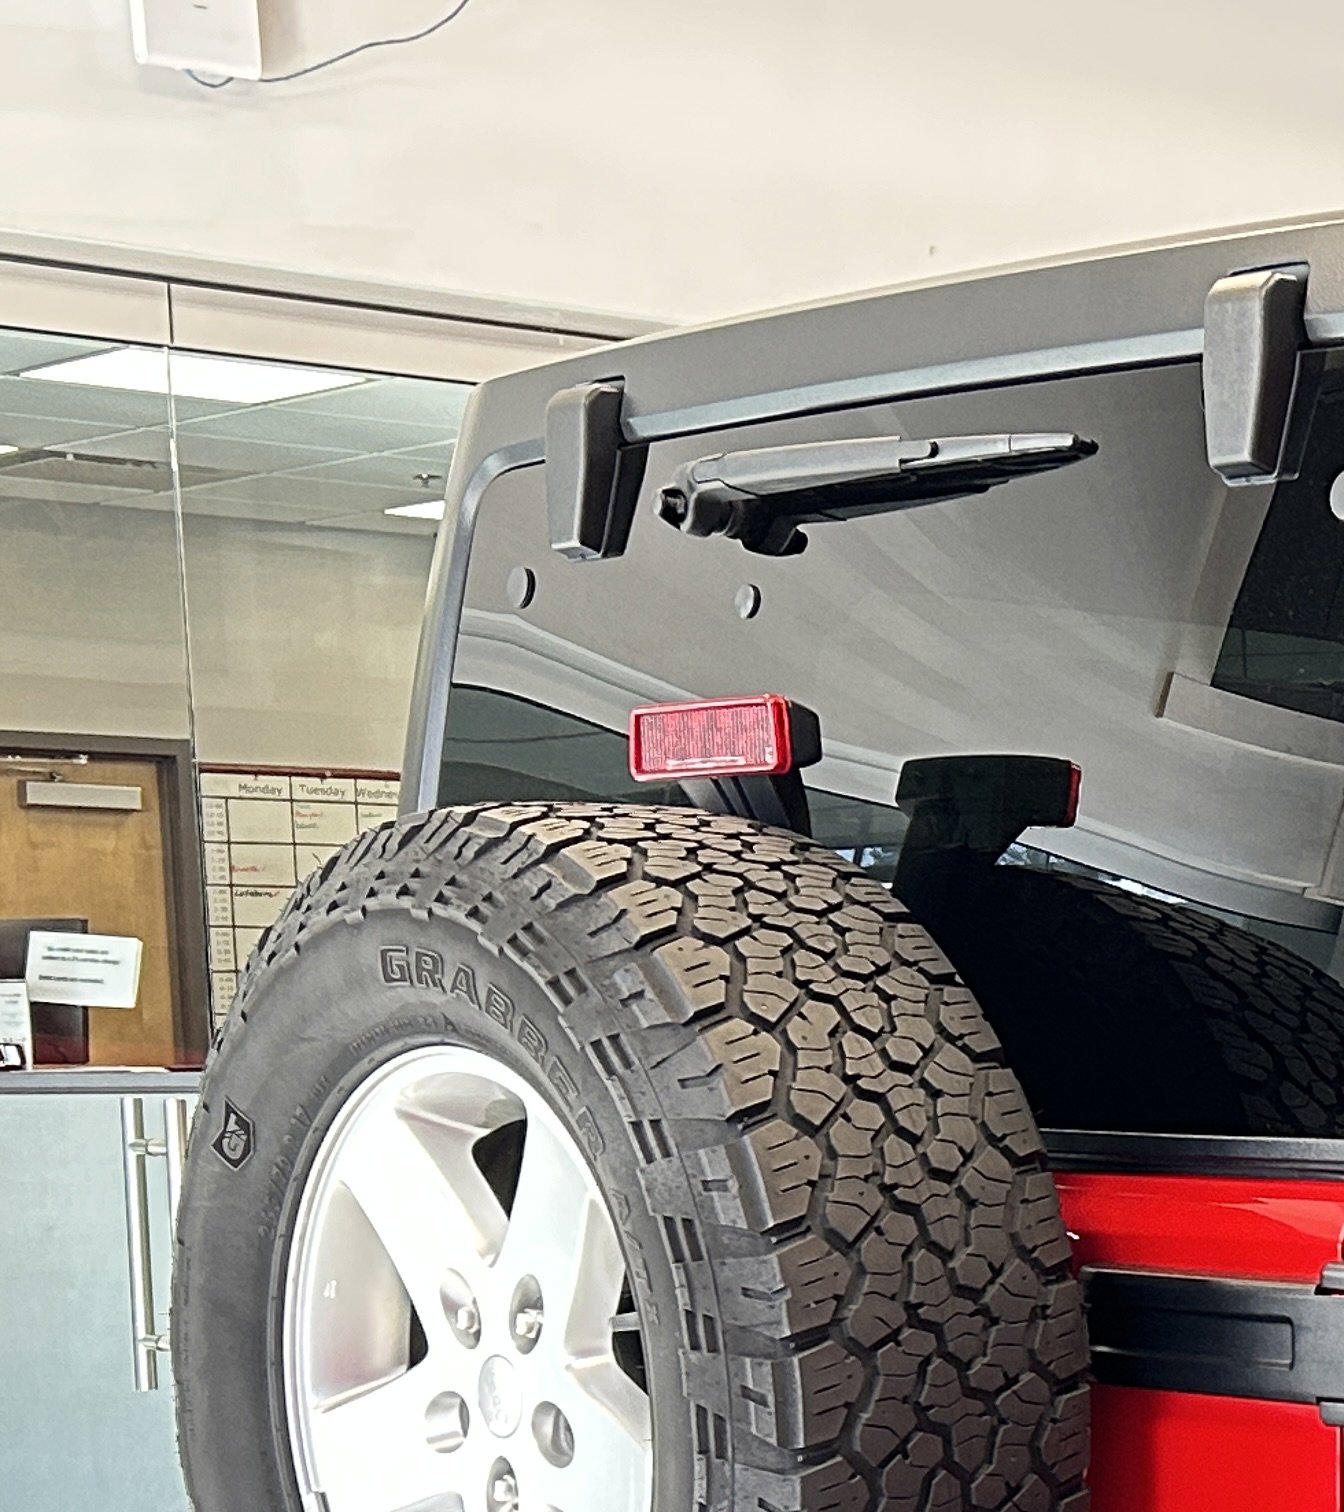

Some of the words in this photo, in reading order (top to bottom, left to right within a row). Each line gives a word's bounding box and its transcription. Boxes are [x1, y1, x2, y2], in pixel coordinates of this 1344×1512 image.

[238, 783, 283, 797] Monday
[298, 783, 346, 799] Tuesday
[380, 944, 606, 1162] GRABBER
